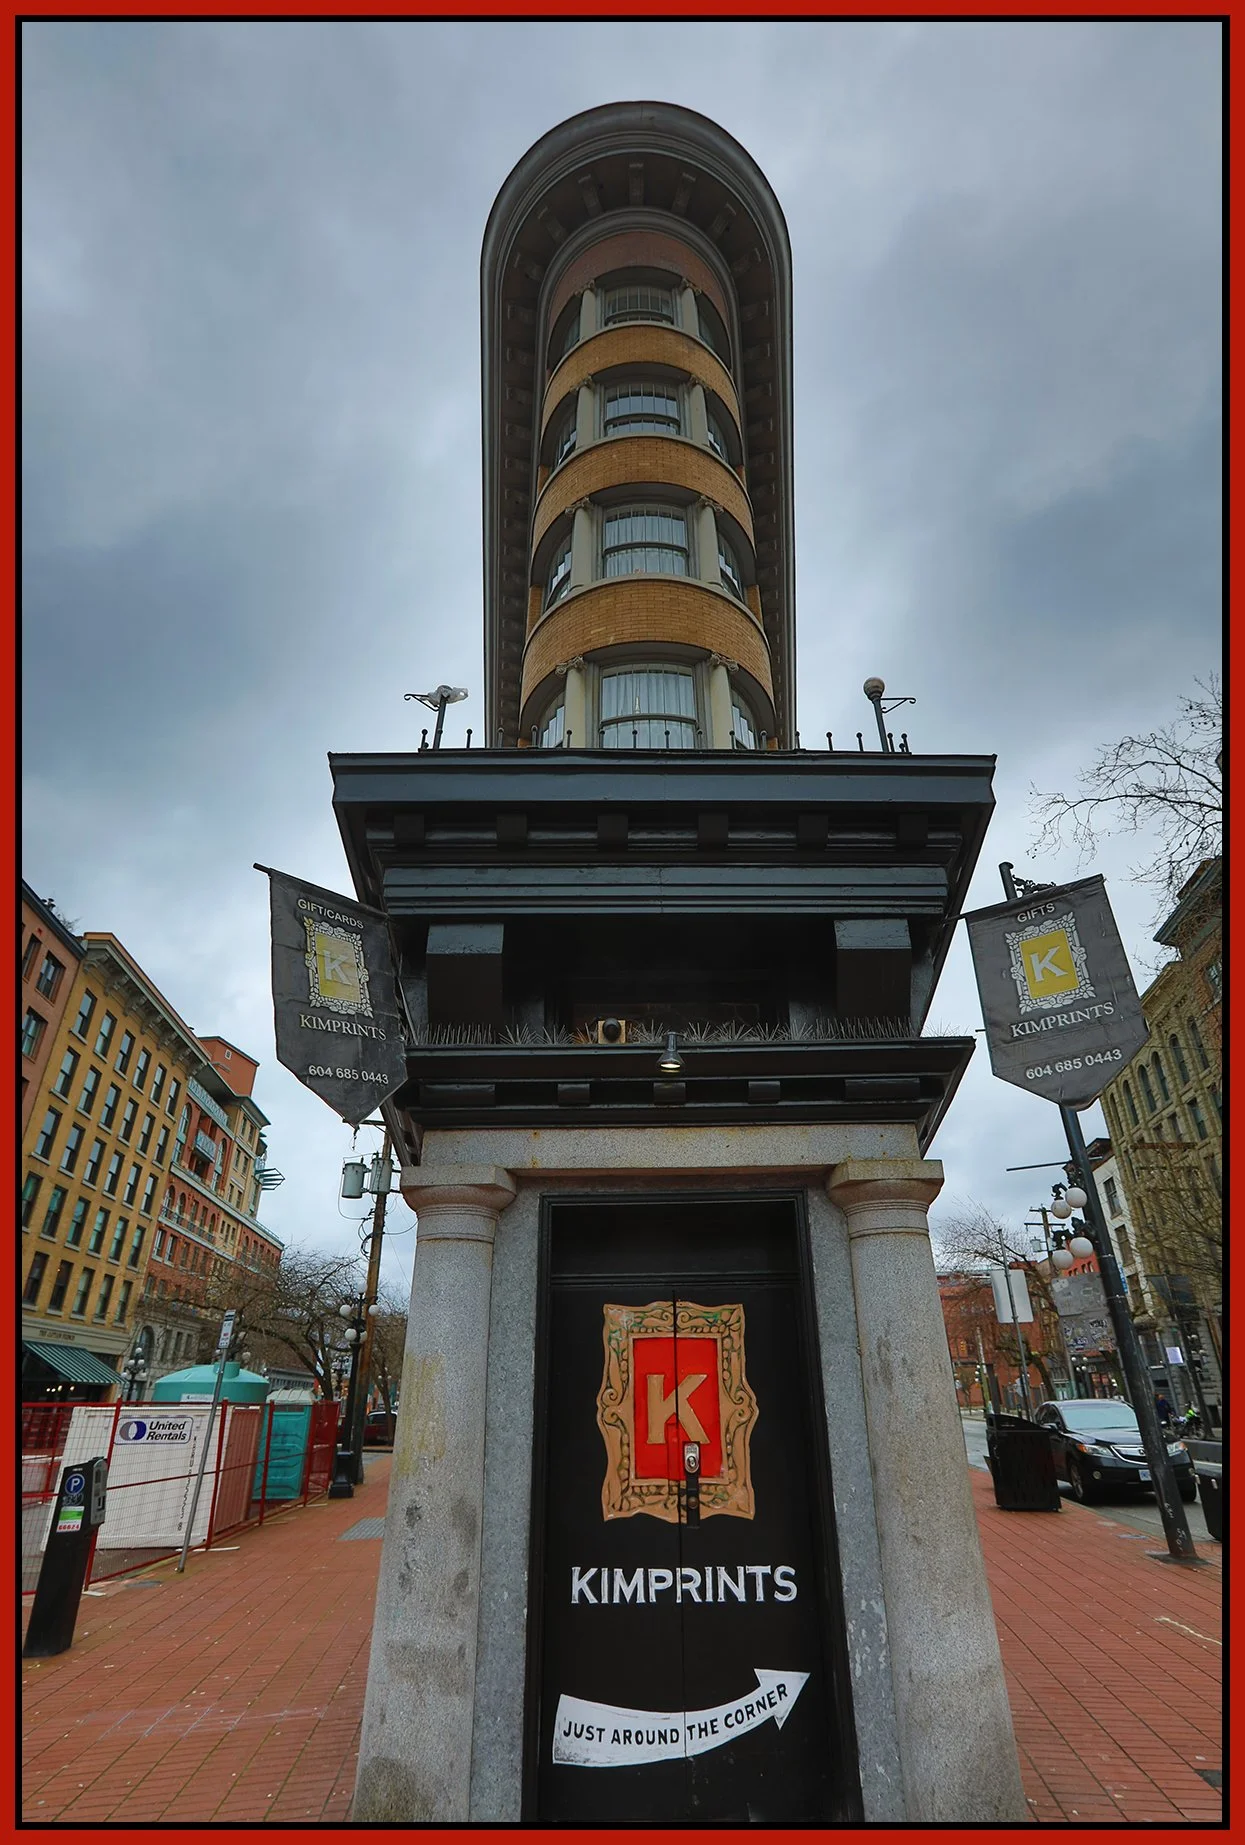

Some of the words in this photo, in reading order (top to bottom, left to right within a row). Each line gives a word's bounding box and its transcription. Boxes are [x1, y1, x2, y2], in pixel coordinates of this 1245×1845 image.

[1017, 902, 1055, 922] GIFTS
[323, 949, 352, 986] K
[1030, 945, 1068, 982] K
[299, 1013, 387, 1041] KIMPRINTS
[1010, 1001, 1114, 1038] KIMPRINTS
[308, 1064, 333, 1077] 604
[336, 1067, 359, 1080] 685
[361, 1070, 389, 1085] 0443
[1026, 1064, 1053, 1080] 604
[1055, 1057, 1082, 1073] 685
[1085, 1048, 1122, 1066] 0443
[646, 1374, 711, 1444] K
[146, 1431, 187, 1441] Rentals
[149, 1420, 187, 1431] United
[70, 1478, 81, 1492] P
[570, 1565, 799, 1604] KIMPRINTS
[563, 1721, 605, 1743] JUST
[611, 1727, 680, 1745] AROUND
[686, 1717, 719, 1741] THE
[723, 1683, 788, 1729] CORNER
